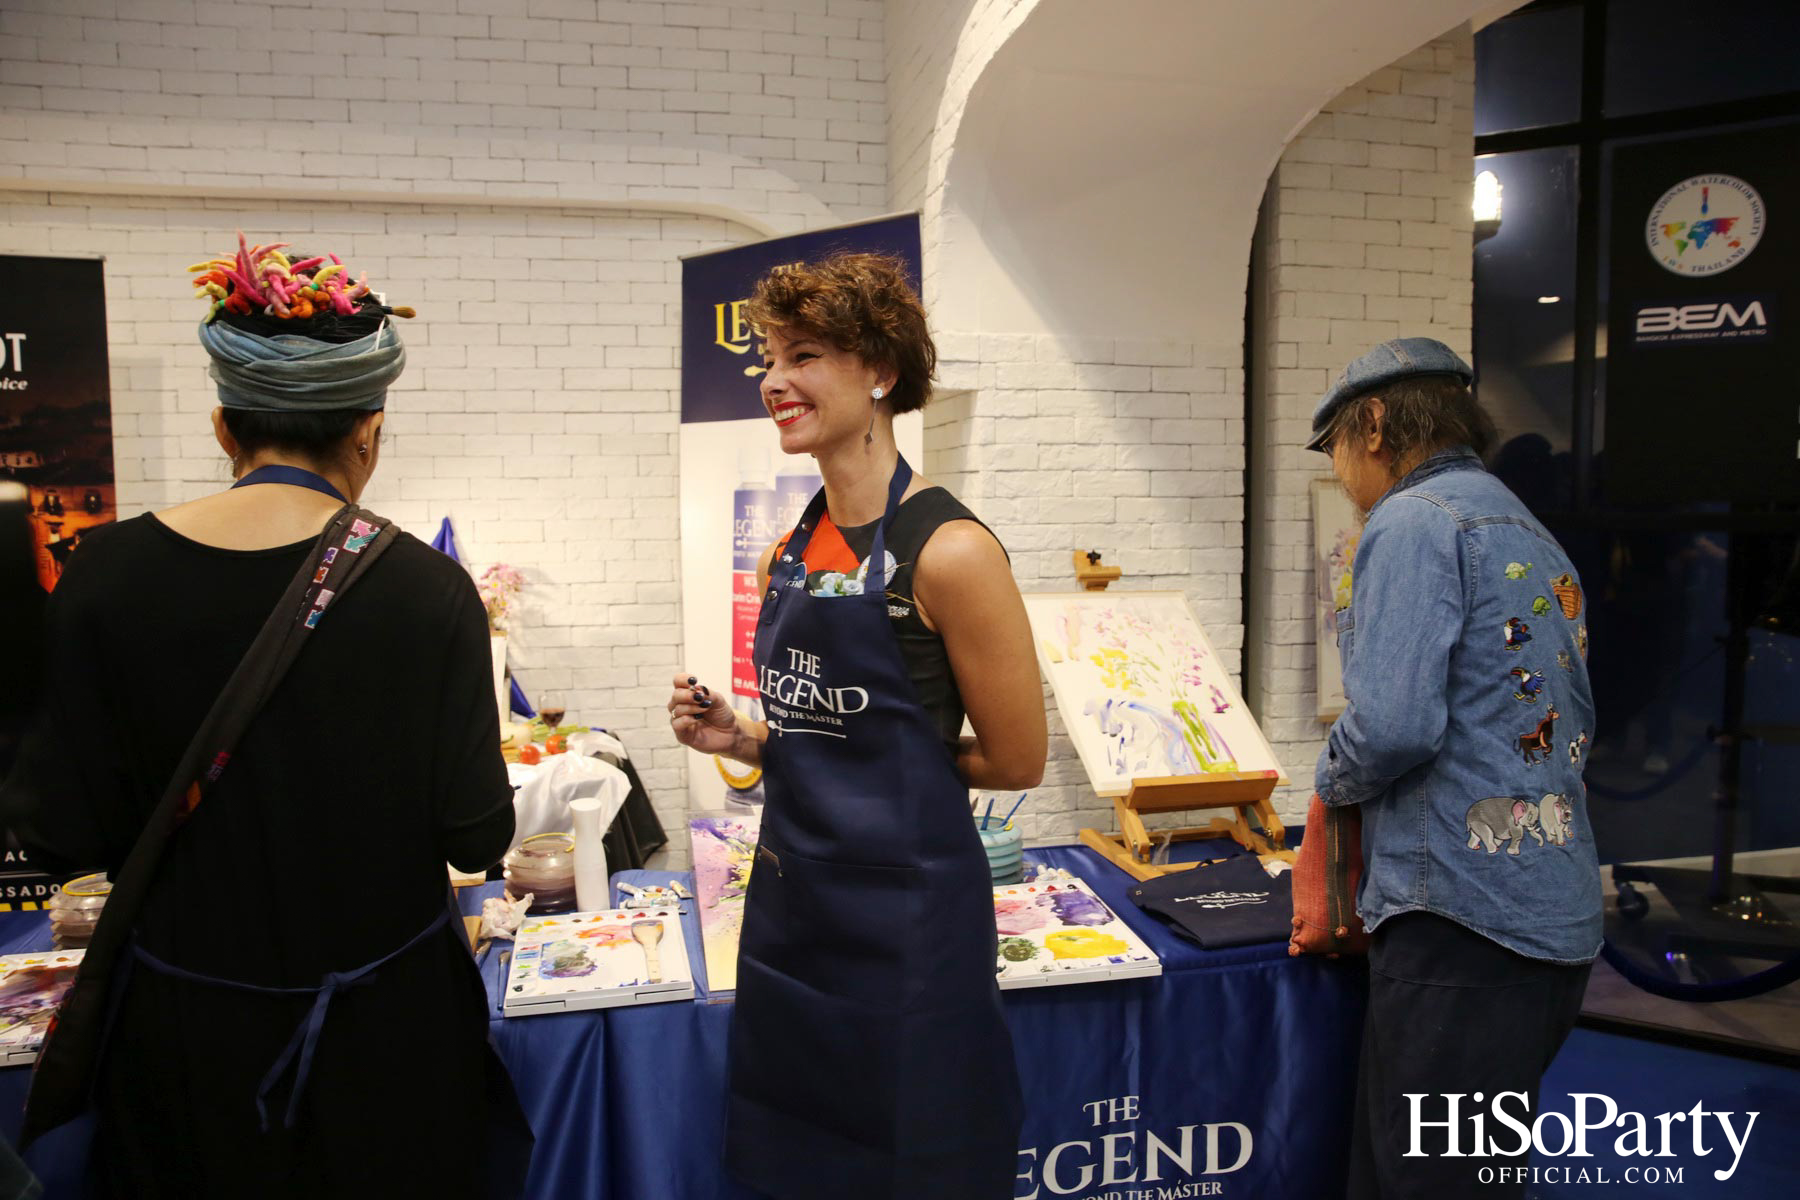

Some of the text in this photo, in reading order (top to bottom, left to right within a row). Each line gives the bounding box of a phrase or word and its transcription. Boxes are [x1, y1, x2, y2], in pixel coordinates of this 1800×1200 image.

[1636, 300, 1767, 333] BEM
[787, 647, 821, 679] THE
[760, 664, 869, 714] LEGEND
[789, 711, 806, 720] THE
[1083, 1095, 1141, 1127] THE
